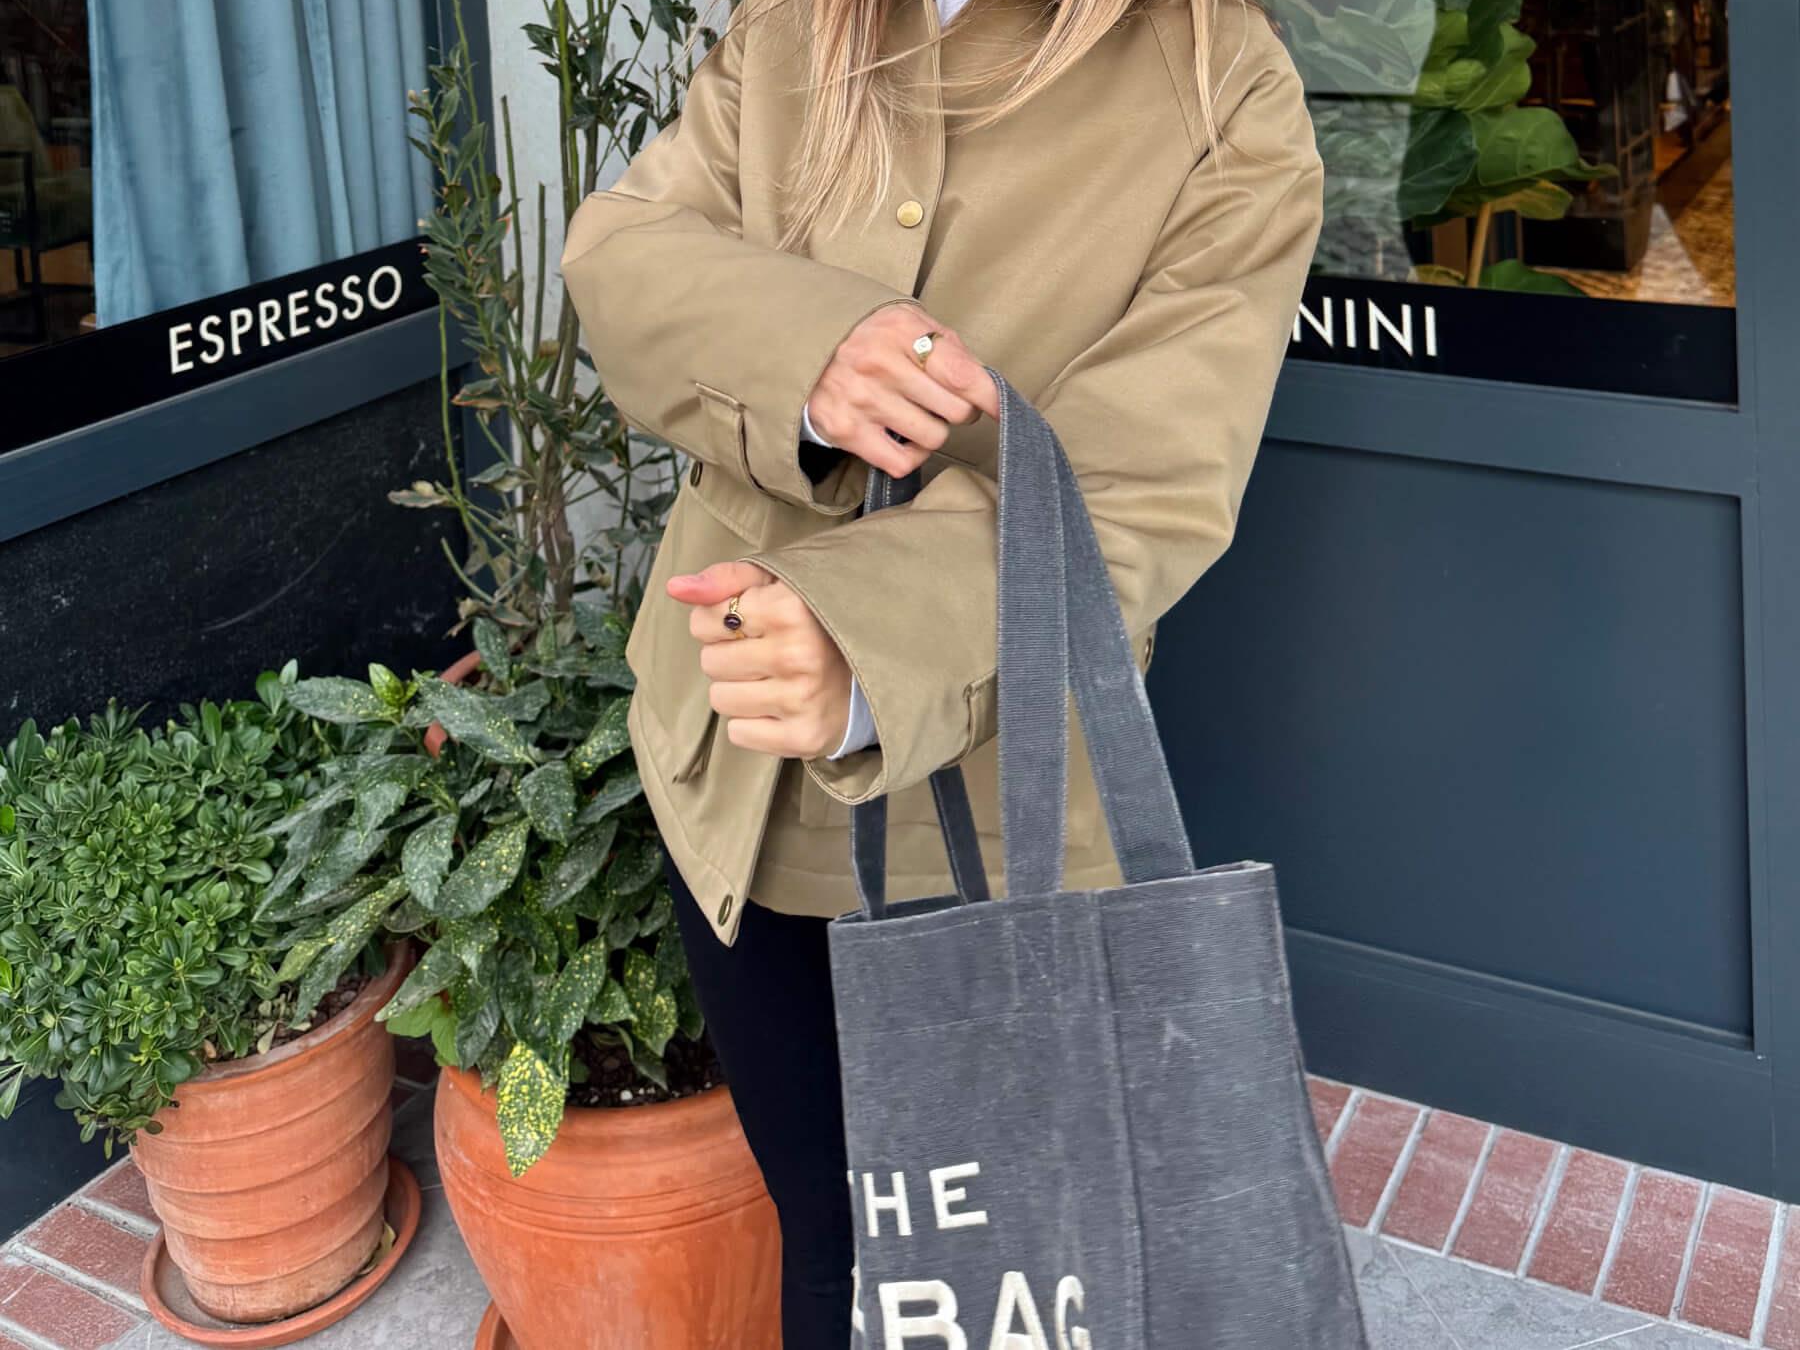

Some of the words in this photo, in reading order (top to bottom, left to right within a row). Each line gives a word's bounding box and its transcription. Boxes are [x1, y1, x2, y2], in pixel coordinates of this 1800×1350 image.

[168, 265, 403, 374] ESPRESSO
[1291, 296, 1439, 357] NINI
[847, 1162, 989, 1237] HE
[878, 1270, 1093, 1350] BAG
